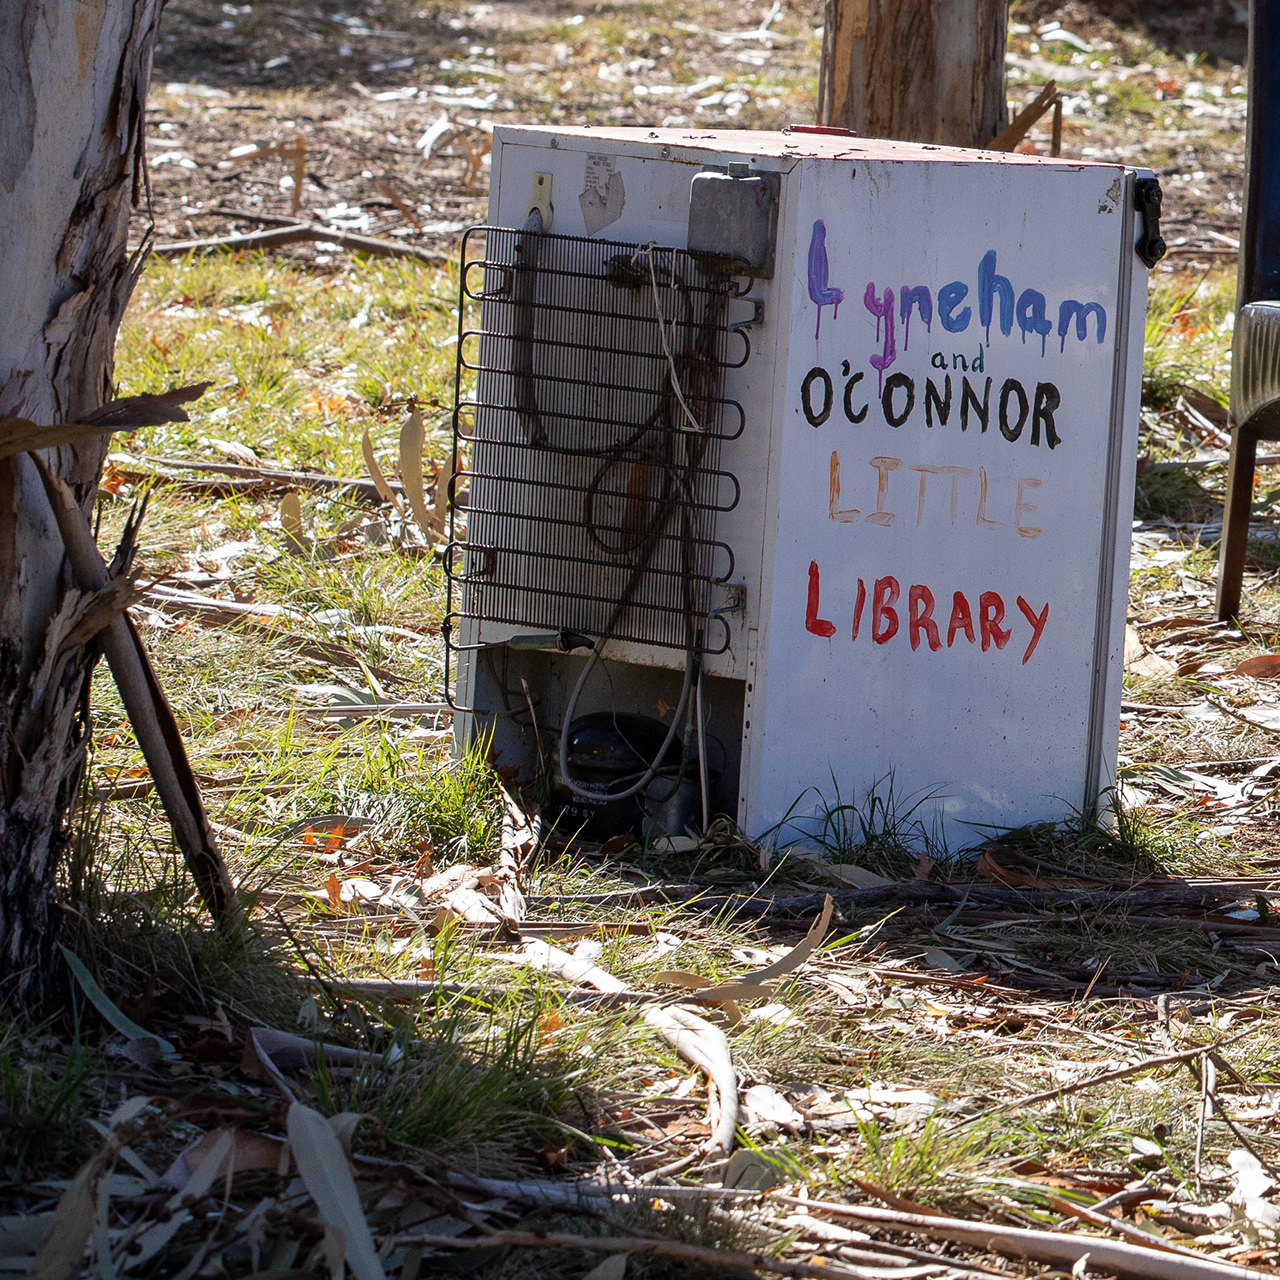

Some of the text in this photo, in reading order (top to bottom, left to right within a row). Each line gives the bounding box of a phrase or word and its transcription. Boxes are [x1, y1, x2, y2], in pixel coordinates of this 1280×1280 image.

[807, 219, 1107, 372] Lyneham
[931, 343, 985, 373] and
[801, 359, 1062, 450] O'CONNOR
[829, 450, 1043, 539] LITTLE
[805, 559, 1050, 666] LIBRARY
